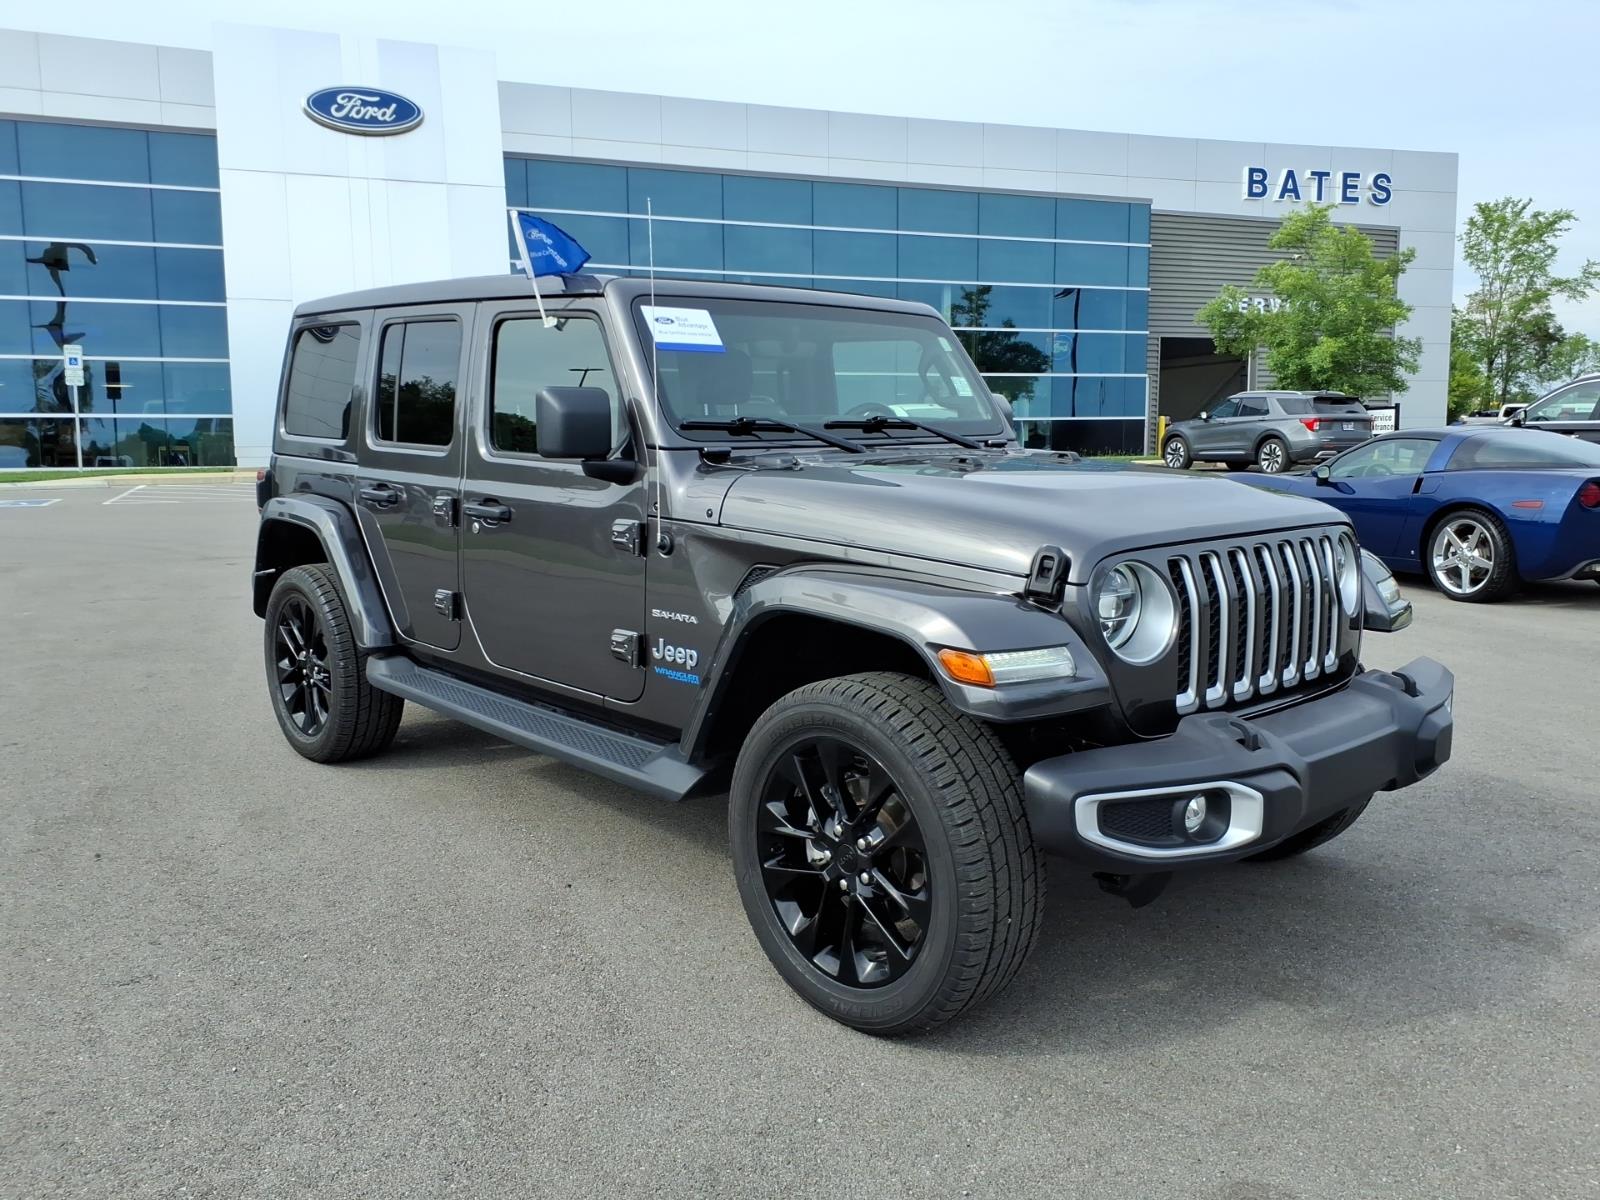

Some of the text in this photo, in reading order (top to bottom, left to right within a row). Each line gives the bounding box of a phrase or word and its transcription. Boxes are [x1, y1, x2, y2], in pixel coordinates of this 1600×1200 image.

[331, 93, 397, 122] Ford
[1243, 166, 1392, 205] BATES
[652, 608, 698, 624] SAHARA
[652, 638, 698, 670] Jeep
